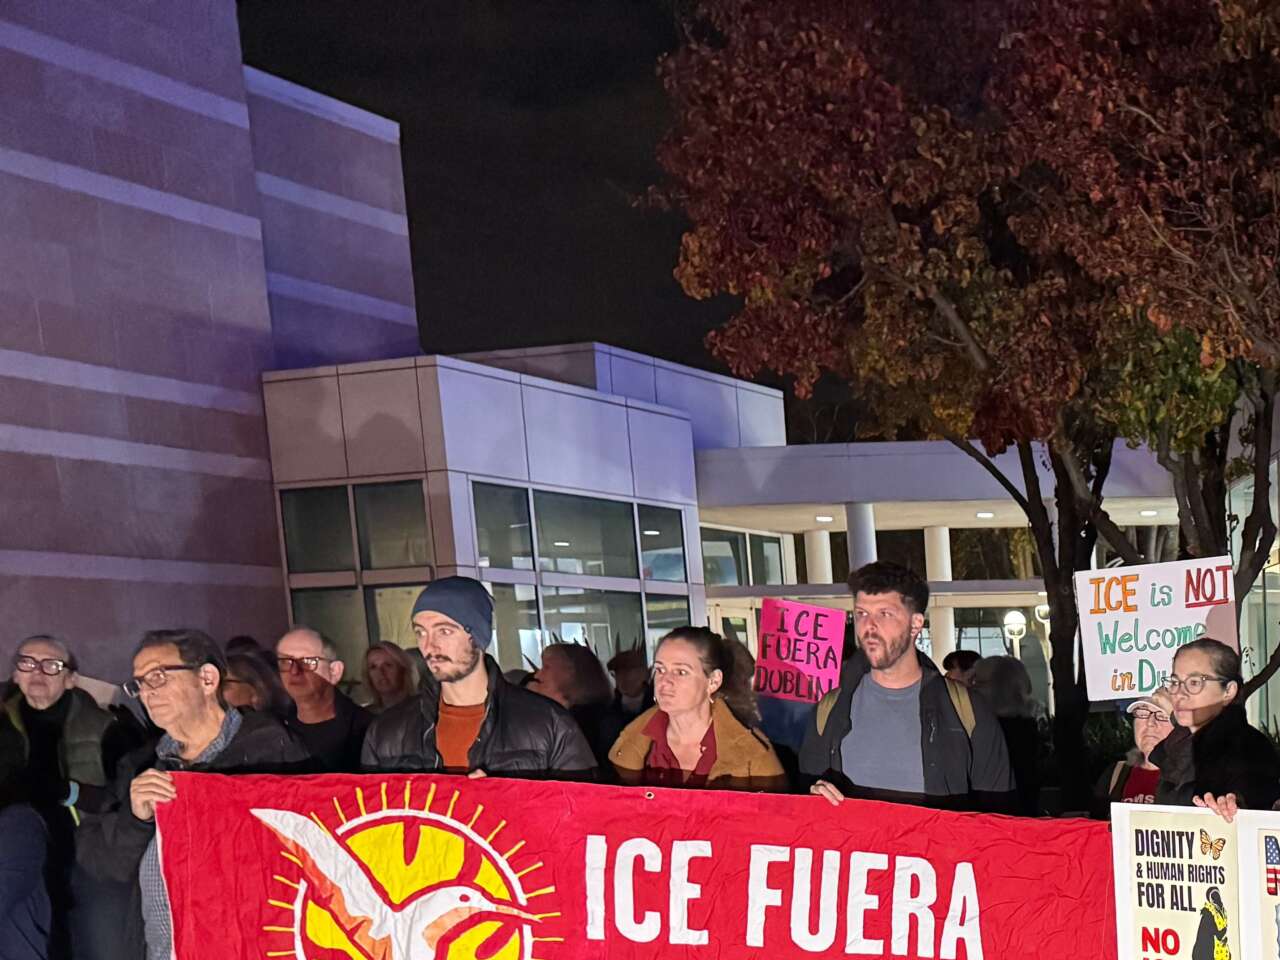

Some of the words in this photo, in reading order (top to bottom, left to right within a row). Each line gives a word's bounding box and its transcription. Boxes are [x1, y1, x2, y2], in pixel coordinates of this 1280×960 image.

[1088, 574, 1139, 614] ICE
[1150, 582, 1173, 607] is
[1184, 565, 1233, 606] NOT
[774, 605, 829, 642] ICE
[761, 633, 838, 670] FUERA
[753, 664, 833, 702] DUBLIN
[1111, 668, 1136, 692] in
[1134, 828, 1195, 860] DIGNITY
[585, 834, 713, 946] ICE
[1136, 862, 1143, 879] &
[1146, 862, 1184, 882] HUMAN
[1187, 864, 1225, 885] RIGHTS
[1137, 882, 1166, 909] FOR
[1170, 885, 1197, 913] ALL
[1141, 926, 1180, 956] NO
